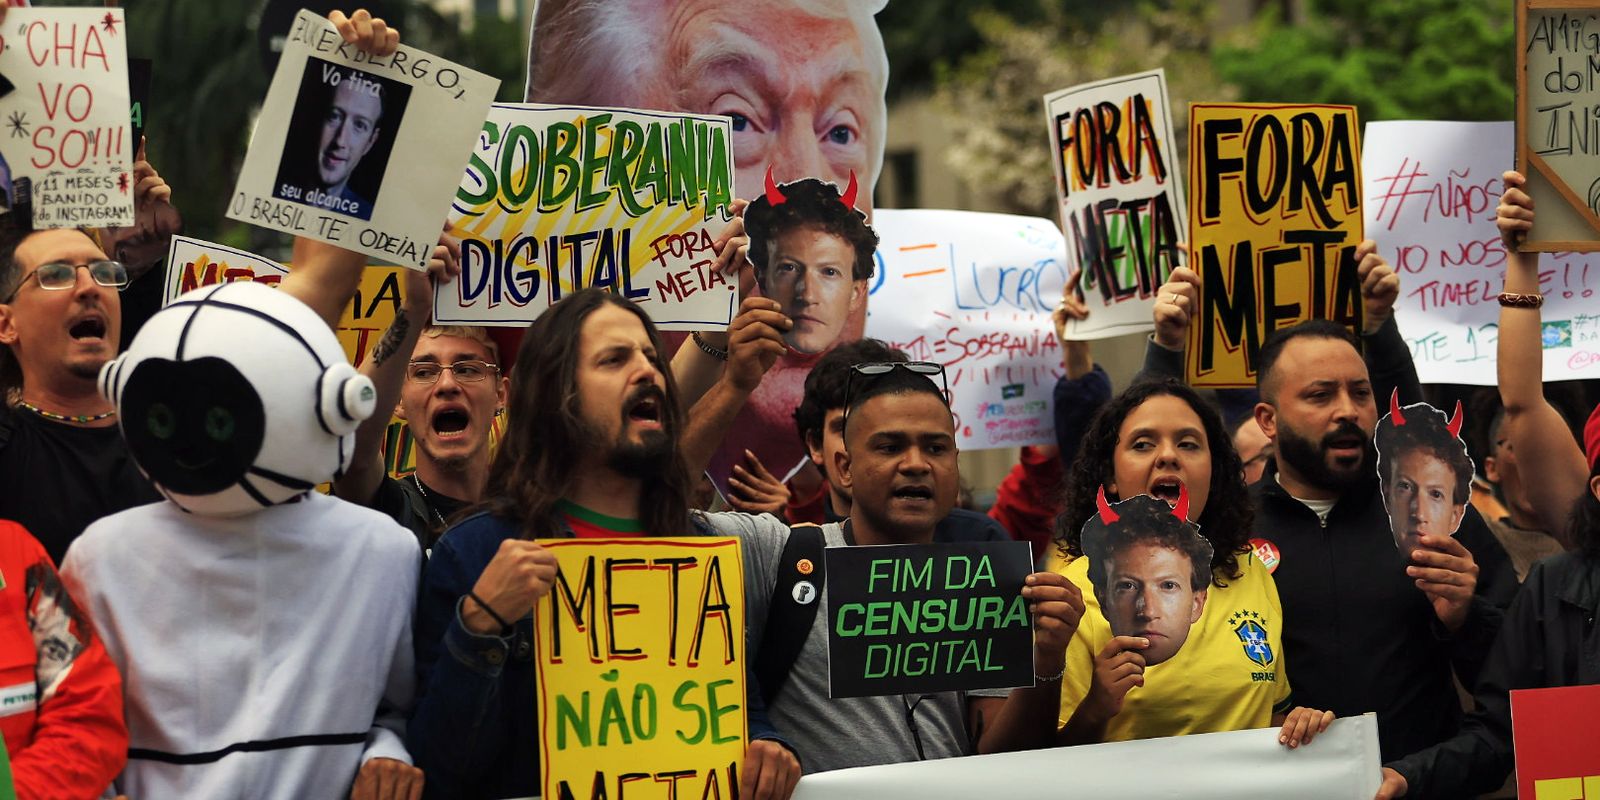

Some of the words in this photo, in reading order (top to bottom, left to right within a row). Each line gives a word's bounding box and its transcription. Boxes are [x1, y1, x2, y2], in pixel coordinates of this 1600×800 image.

[37, 82, 93, 122] VO
[322, 64, 342, 87] Vo
[349, 73, 383, 98] tira
[455, 113, 734, 220] SOBERANIA
[1056, 93, 1167, 198] FORA
[1199, 112, 1358, 229] FORA
[43, 178, 58, 191] 11
[65, 176, 115, 190] MESES
[280, 183, 302, 201] seu
[305, 189, 360, 214] alcance
[232, 192, 246, 216] O
[250, 197, 305, 232] BRASIL
[318, 216, 348, 242] TE
[459, 228, 651, 307] DIGITAL
[649, 228, 720, 267] FORA
[1069, 191, 1182, 307] META
[1197, 231, 1362, 374] META
[868, 557, 933, 593] FIM
[944, 554, 997, 591] DA
[550, 555, 735, 667] META
[835, 595, 1028, 637] CENSURA
[864, 638, 1004, 679] DIGITAL
[556, 669, 657, 750] NÃO
[672, 679, 740, 745] SE
